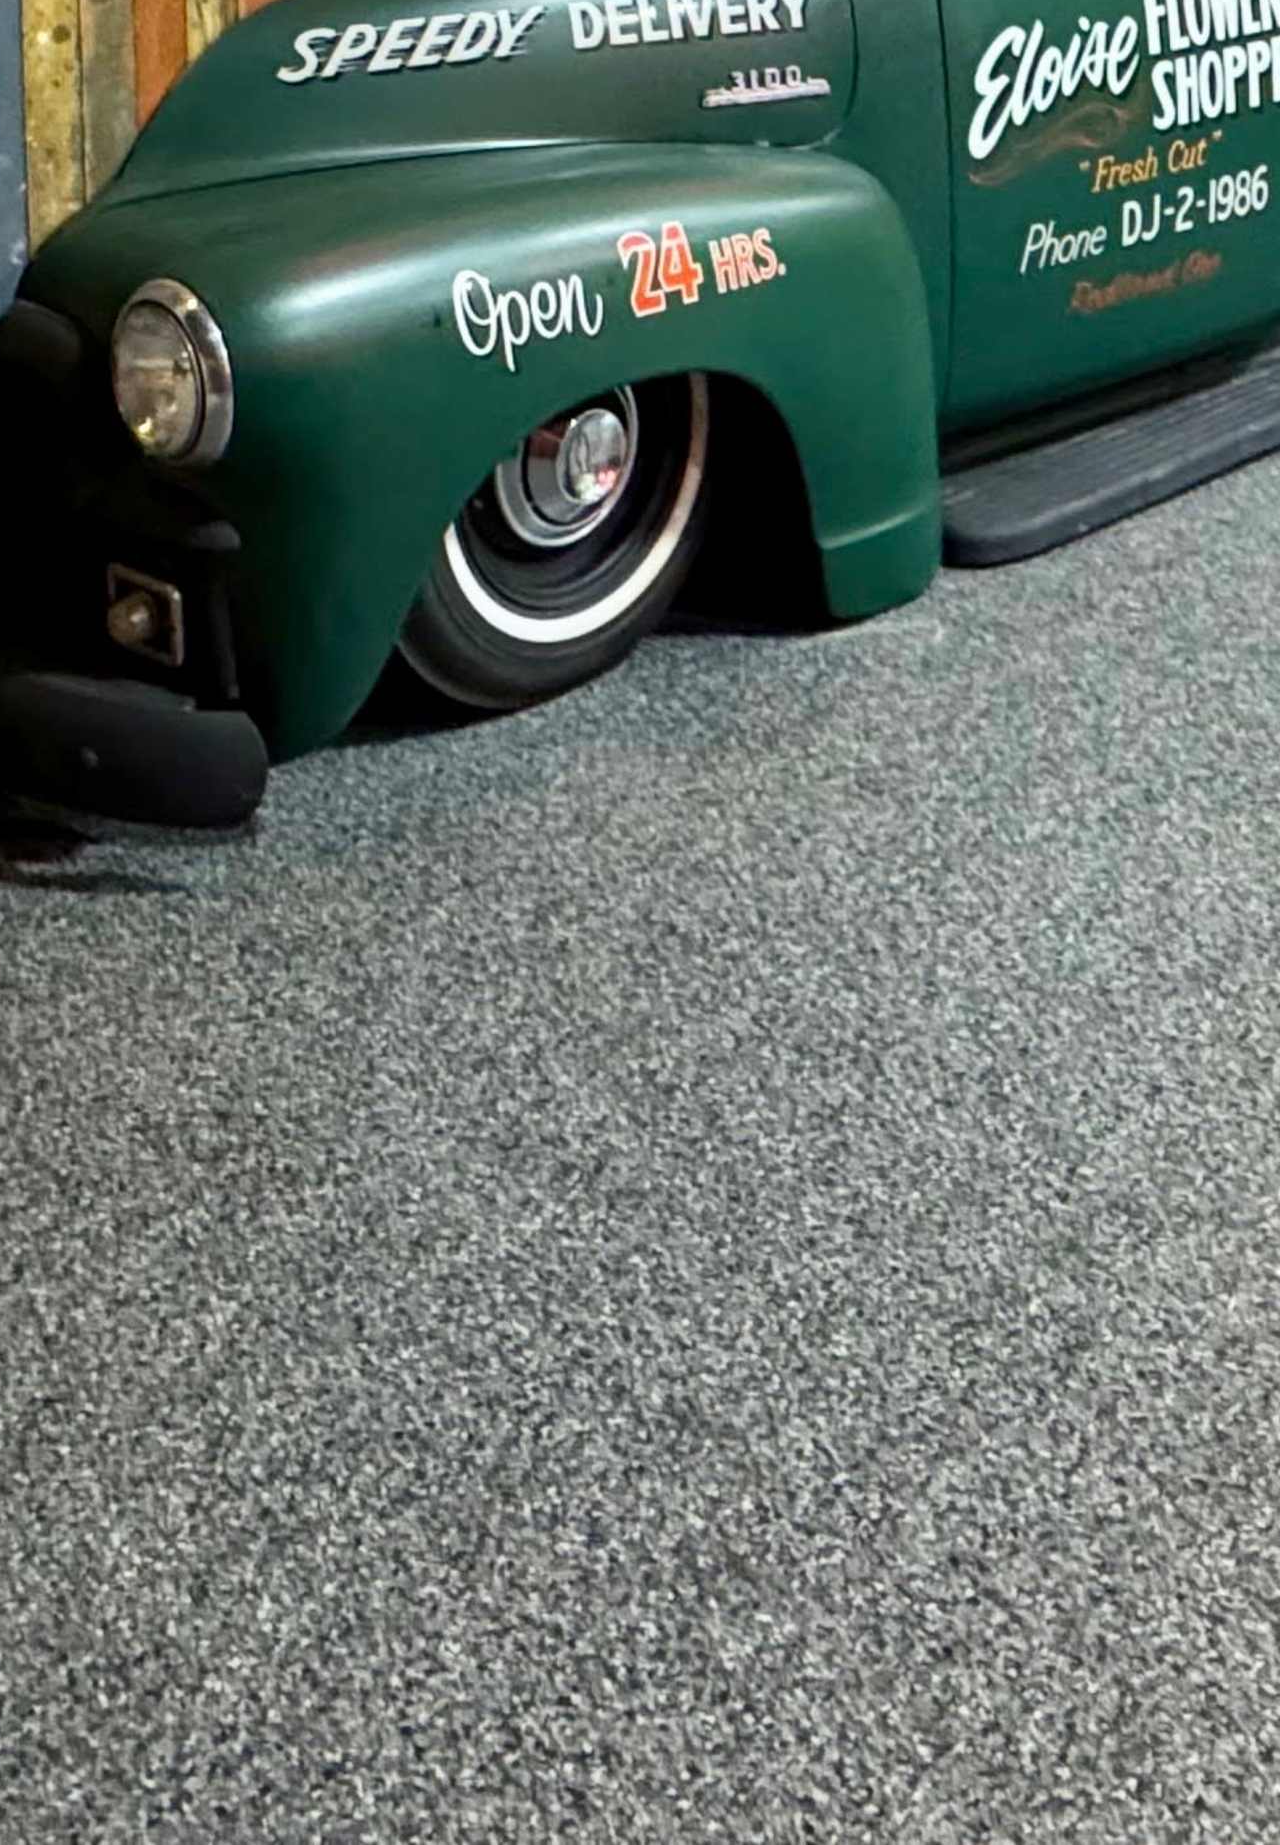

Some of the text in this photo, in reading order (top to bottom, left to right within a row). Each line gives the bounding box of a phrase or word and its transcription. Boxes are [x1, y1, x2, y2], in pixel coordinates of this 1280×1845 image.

[276, 4, 548, 84] SPEEDY
[730, 64, 802, 92] 3100
[967, 15, 1141, 160] Eloise
[1019, 164, 1270, 275] Phone DJ-2-1986
[451, 220, 786, 372] Open 24 HRS.
